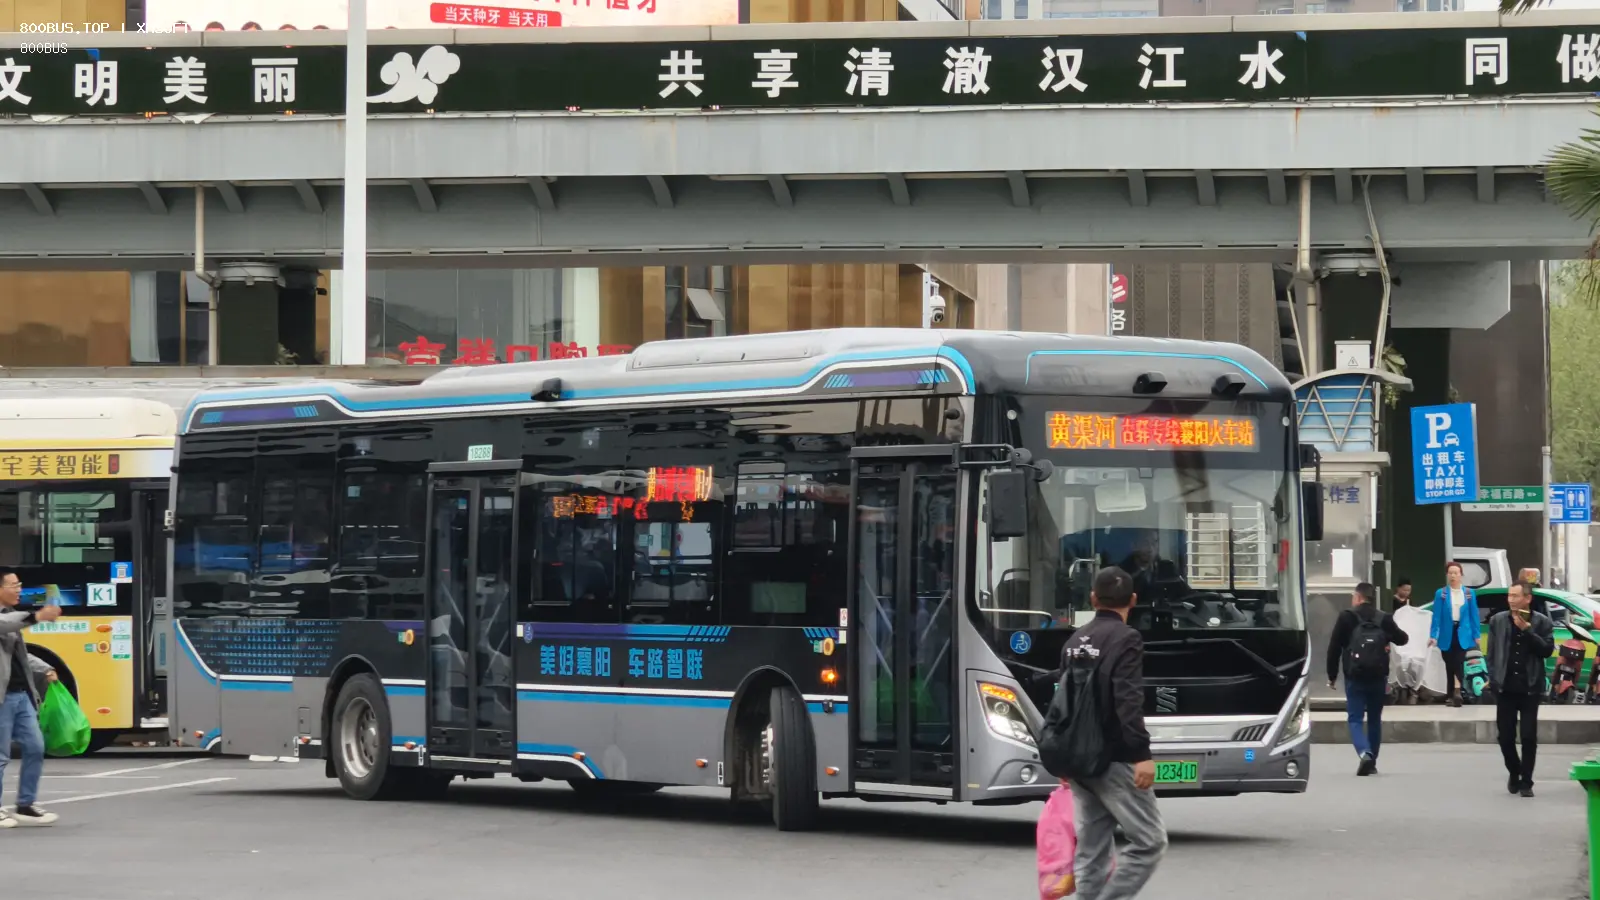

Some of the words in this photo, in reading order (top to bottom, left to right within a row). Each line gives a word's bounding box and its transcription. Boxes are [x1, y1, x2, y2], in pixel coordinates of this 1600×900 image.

[445, 6, 501, 24] 当天种牙
[508, 10, 548, 27] 当天用
[0, 56, 299, 106] 文明美丽
[657, 40, 1286, 99] 共享清澈汉江水
[1048, 412, 1117, 449] 黄渠河
[1424, 412, 1452, 449] P
[1422, 450, 1465, 466] 出租车
[1424, 465, 1465, 478] TAXI
[1425, 477, 1465, 490] 即停即走
[93, 587, 114, 602] K1
[539, 645, 611, 677] 美好襄阳
[628, 647, 703, 680] 车路智联
